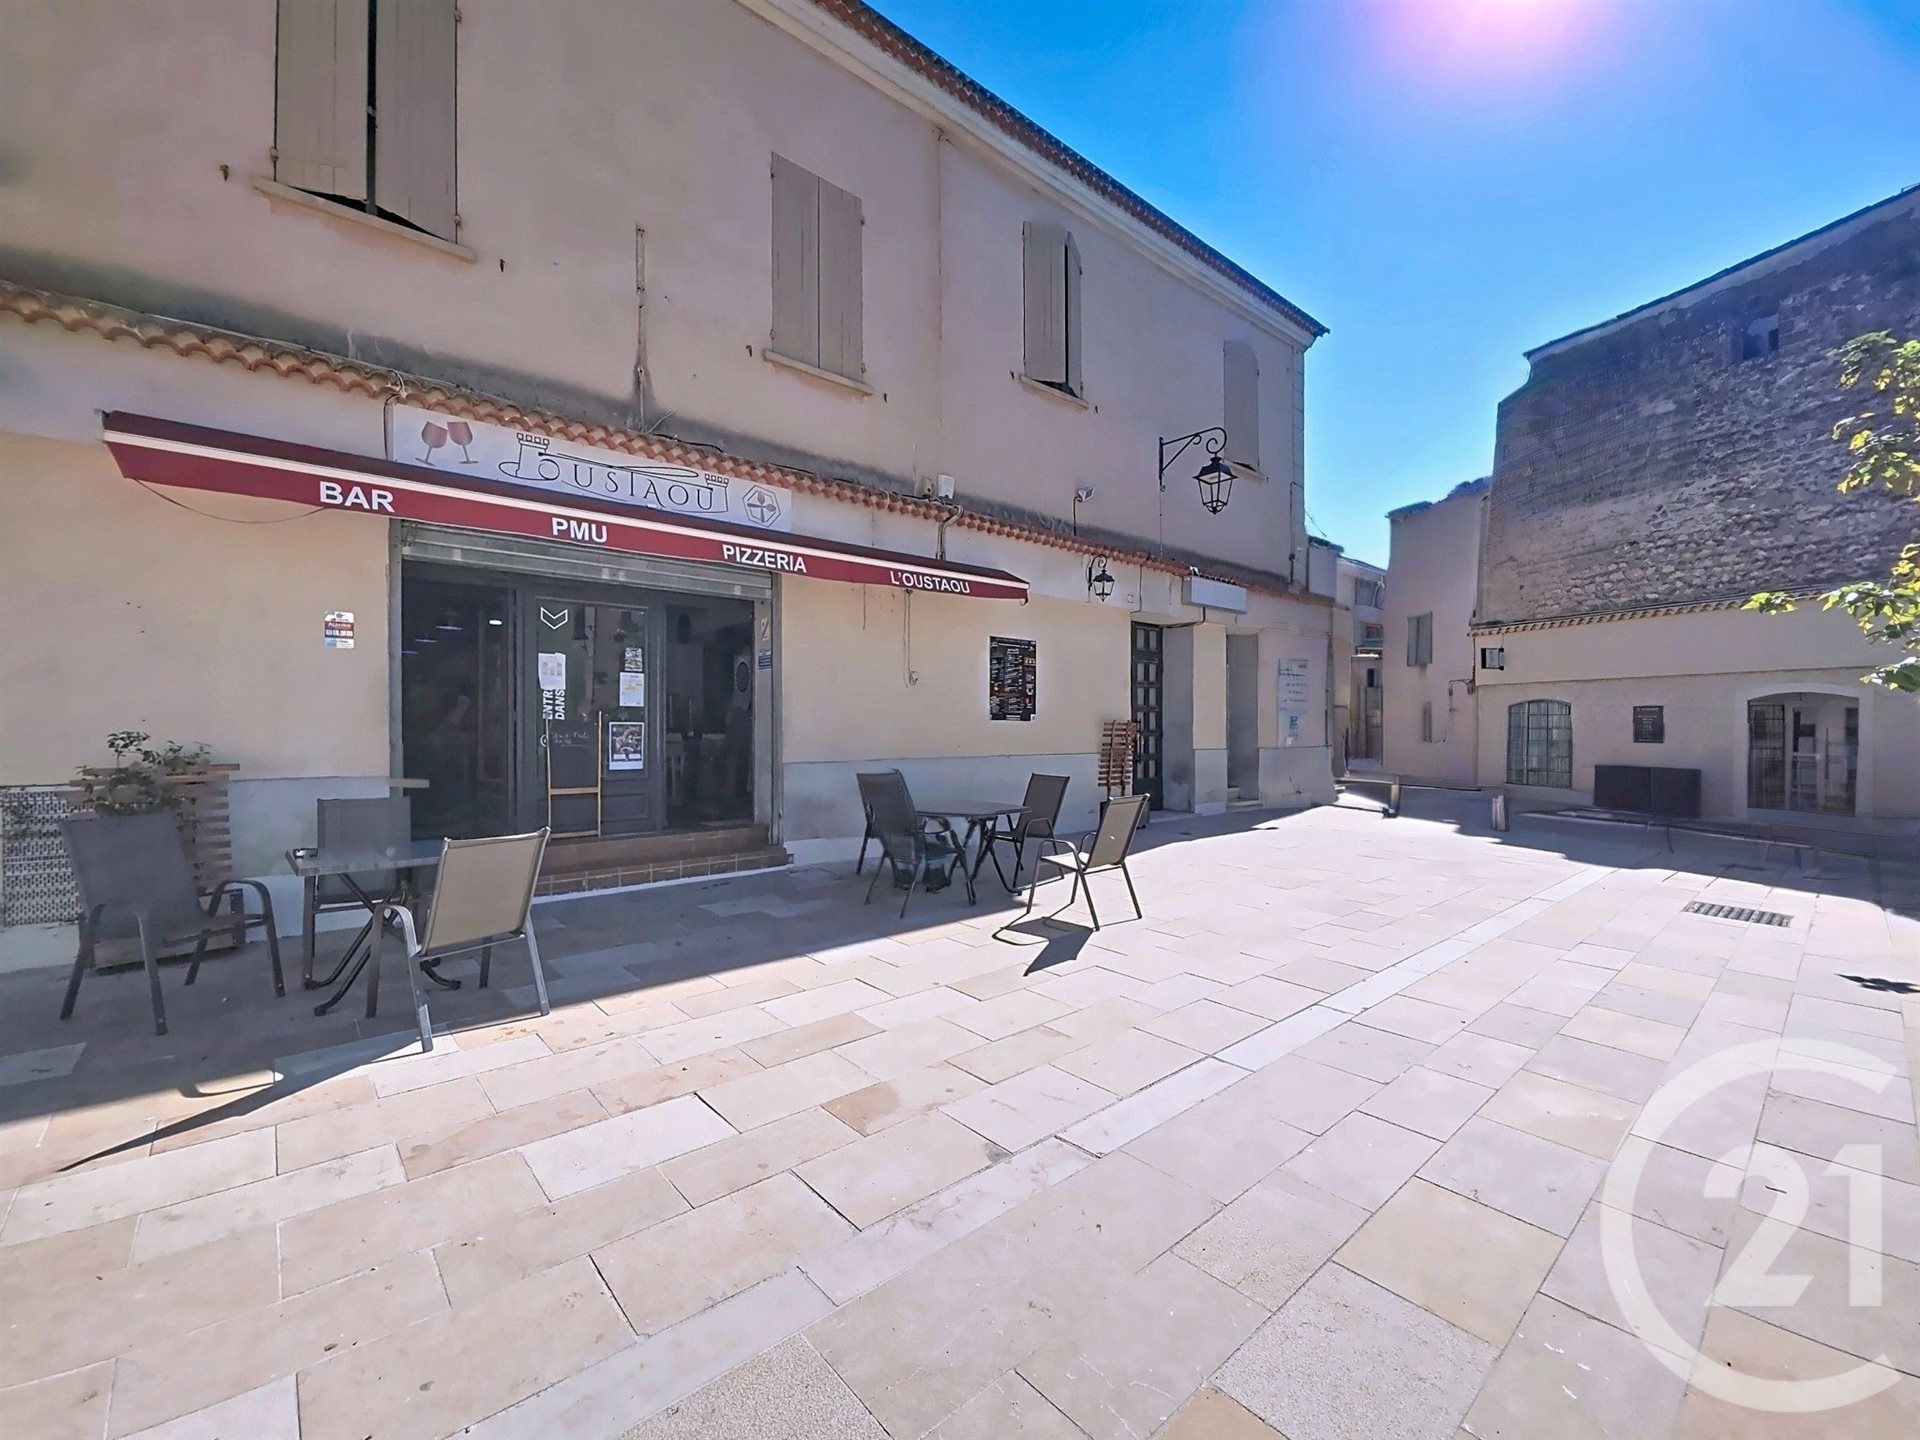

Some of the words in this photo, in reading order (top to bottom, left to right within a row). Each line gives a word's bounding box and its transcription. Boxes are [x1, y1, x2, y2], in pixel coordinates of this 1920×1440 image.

[318, 480, 396, 514] BAR
[550, 516, 609, 545] PMU
[721, 543, 808, 574] PIZZERIA
[889, 569, 971, 595] L'OUSTAOU
[542, 688, 554, 720] ENTR
